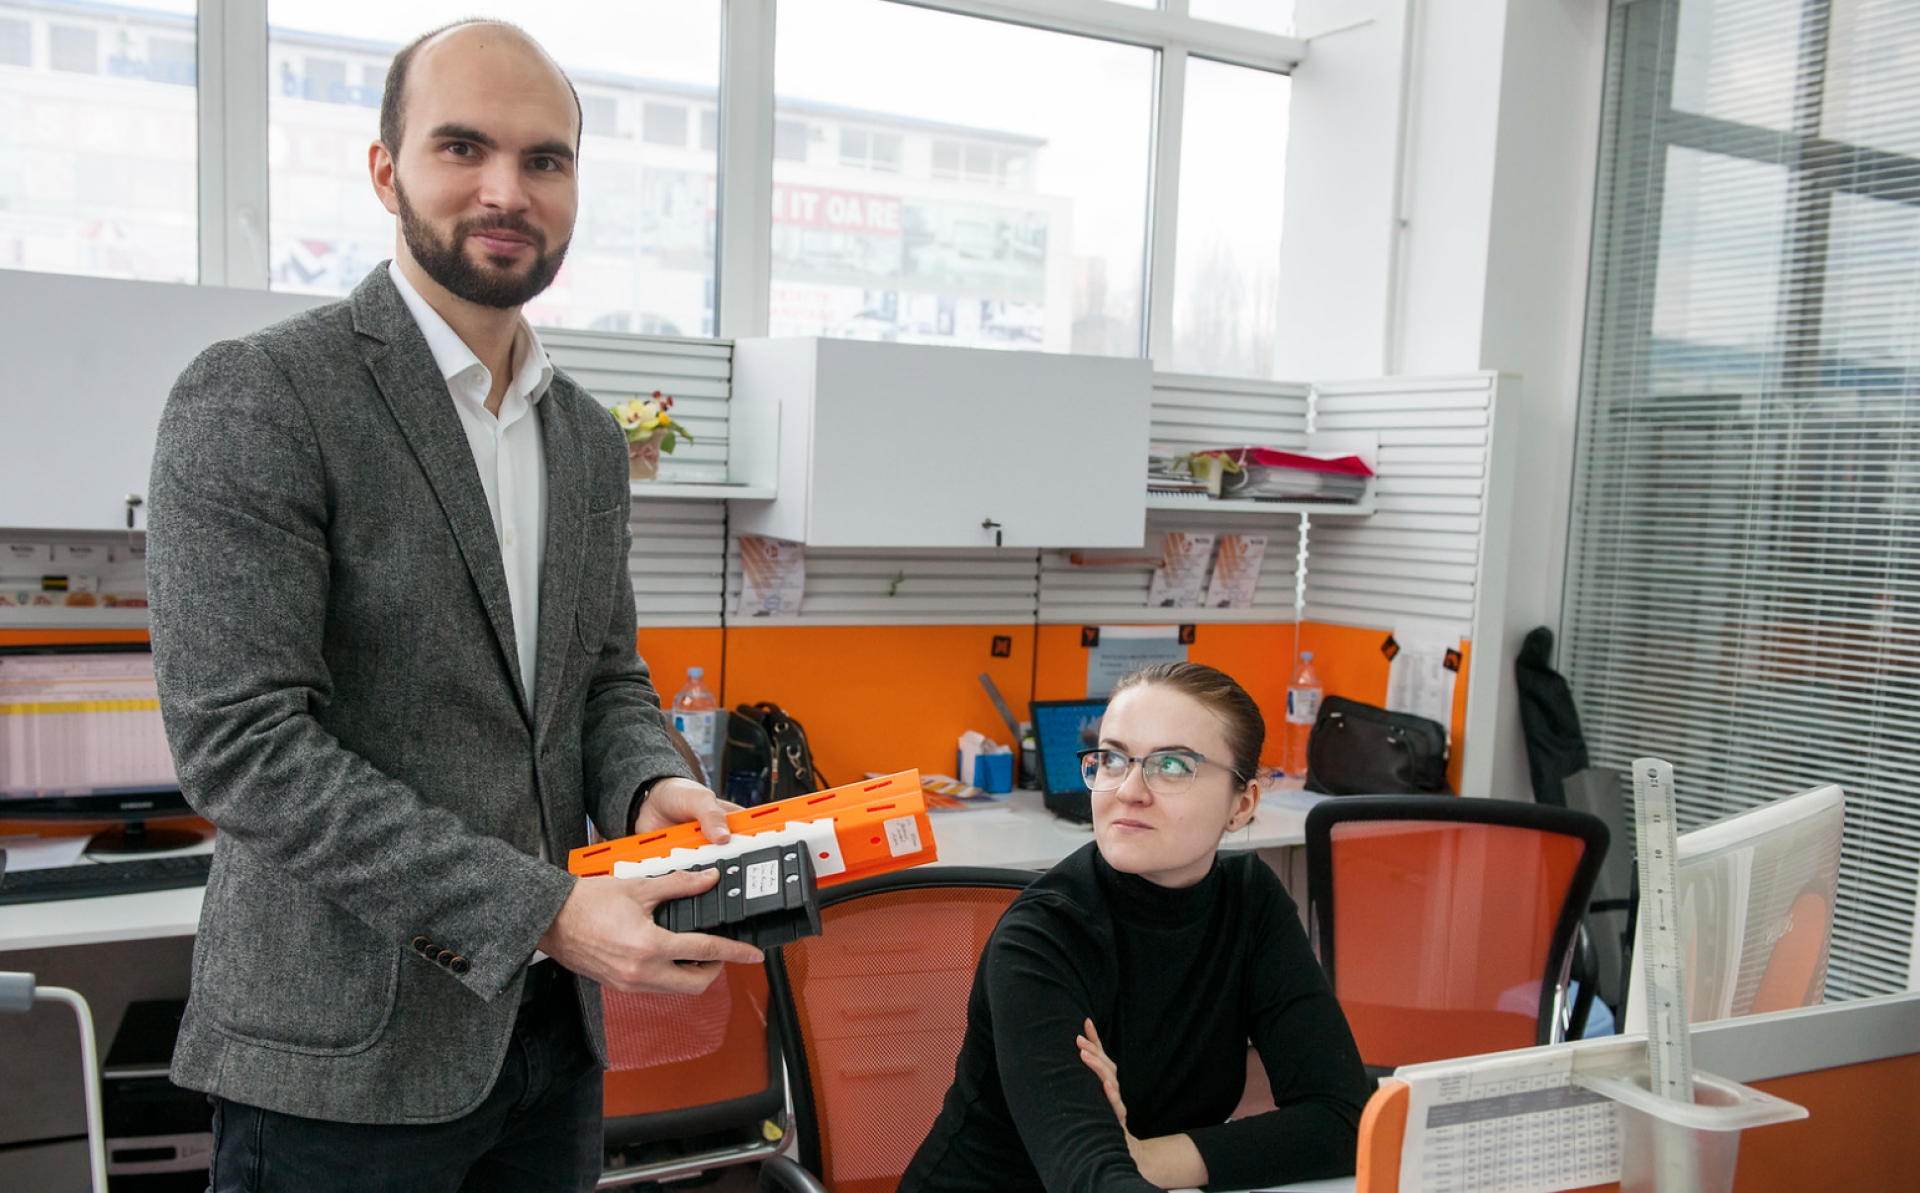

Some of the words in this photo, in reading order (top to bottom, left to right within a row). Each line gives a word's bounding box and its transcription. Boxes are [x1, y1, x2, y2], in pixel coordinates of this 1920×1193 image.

[1651, 778, 1659, 788] 12
[1653, 814, 1661, 823] 11
[1655, 848, 1663, 859] 10
